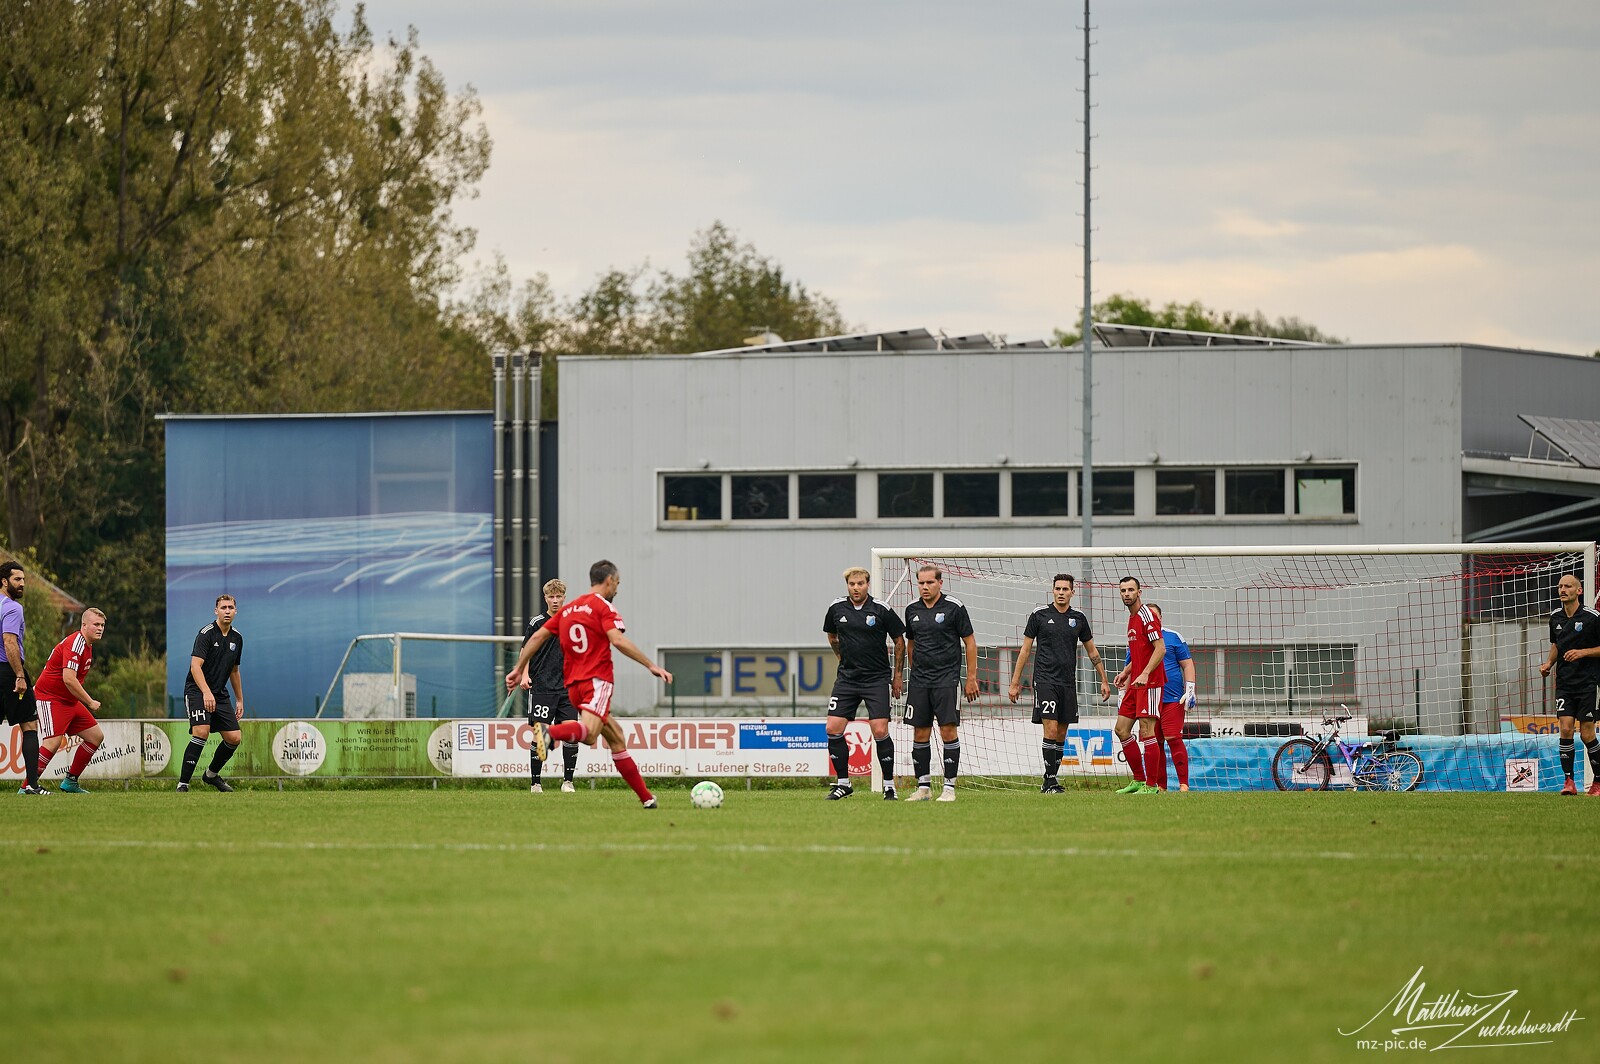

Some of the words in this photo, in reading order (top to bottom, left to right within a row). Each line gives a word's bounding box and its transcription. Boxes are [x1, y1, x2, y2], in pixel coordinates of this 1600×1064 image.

[568, 624, 588, 654] 9
[534, 704, 550, 718] 38
[1042, 700, 1056, 714] 29
[192, 710, 206, 722] 44
[439, 738, 452, 748] Sa
[281, 750, 319, 761] Apotheke
[496, 764, 530, 773] 08684
[587, 764, 618, 773] 8341
[698, 763, 749, 773] Laufener
[753, 763, 791, 773] Straße
[796, 763, 809, 772] 22
